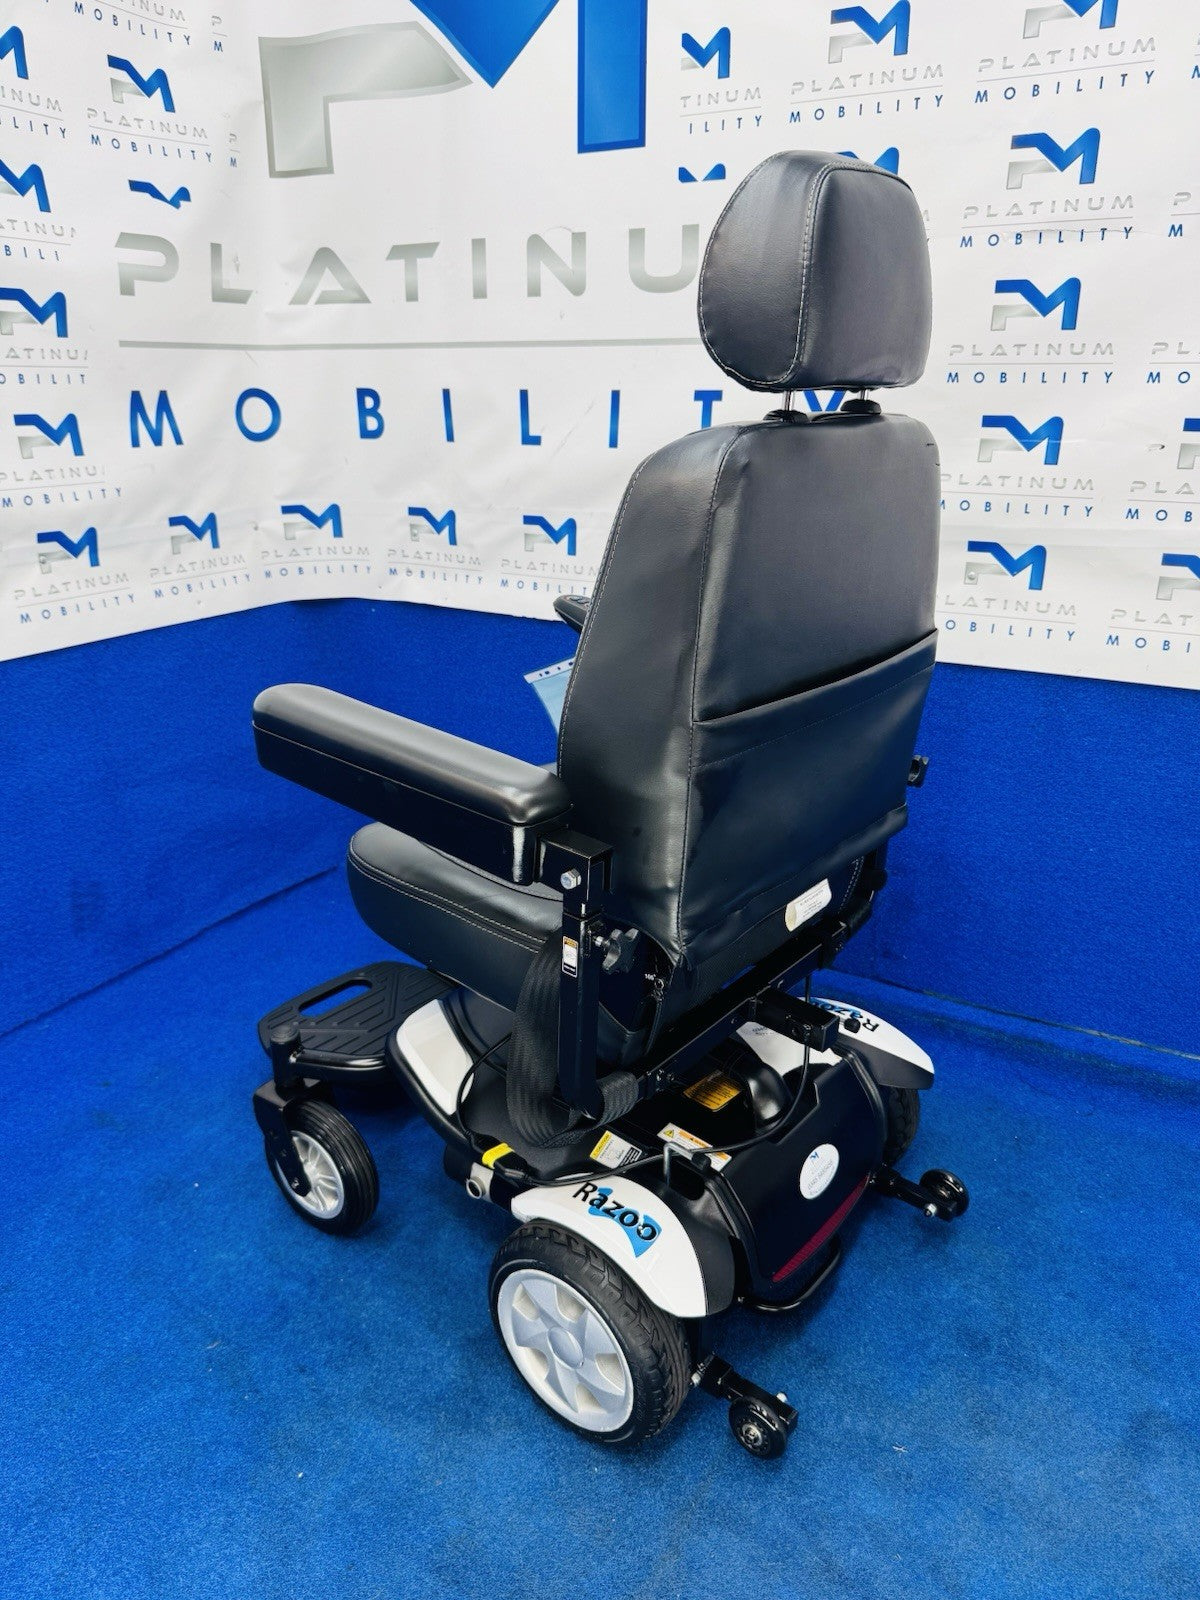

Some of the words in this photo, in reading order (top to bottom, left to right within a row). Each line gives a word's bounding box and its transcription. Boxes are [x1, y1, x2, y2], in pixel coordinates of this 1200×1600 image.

[119, 0, 186, 21] INUM
[74, 1, 191, 45] MOBILITY
[978, 37, 1156, 73] PLATINUM
[791, 64, 944, 95] PLATINUM
[975, 70, 1155, 103] MOBILITY
[789, 95, 944, 123] MOBILITY
[0, 116, 67, 139] LITY
[87, 107, 208, 139] PLATINUM
[91, 134, 212, 162] MOBILITY
[963, 194, 1134, 219] PLATINUM
[960, 226, 1133, 248] MOBILITY
[114, 224, 700, 305] PLATINU
[949, 342, 1114, 356] PLATINUM
[947, 371, 1113, 384] MOBILITY
[0, 465, 105, 482] PLATINU
[2, 487, 122, 508] MOBILITY
[261, 545, 370, 560] PLATINUM
[388, 548, 482, 566] PLATINUM
[150, 554, 246, 578] PLATINUM
[264, 565, 373, 579] MOBILITY
[388, 568, 483, 585] MOBILITY
[14, 572, 129, 600] PLATINUM
[154, 574, 250, 598] MOBILITY
[500, 577, 587, 595] MOBILIT
[20, 593, 136, 624] MOBILITY
[936, 595, 1076, 616] LATINUM
[945, 619, 1075, 642] OBILITY
